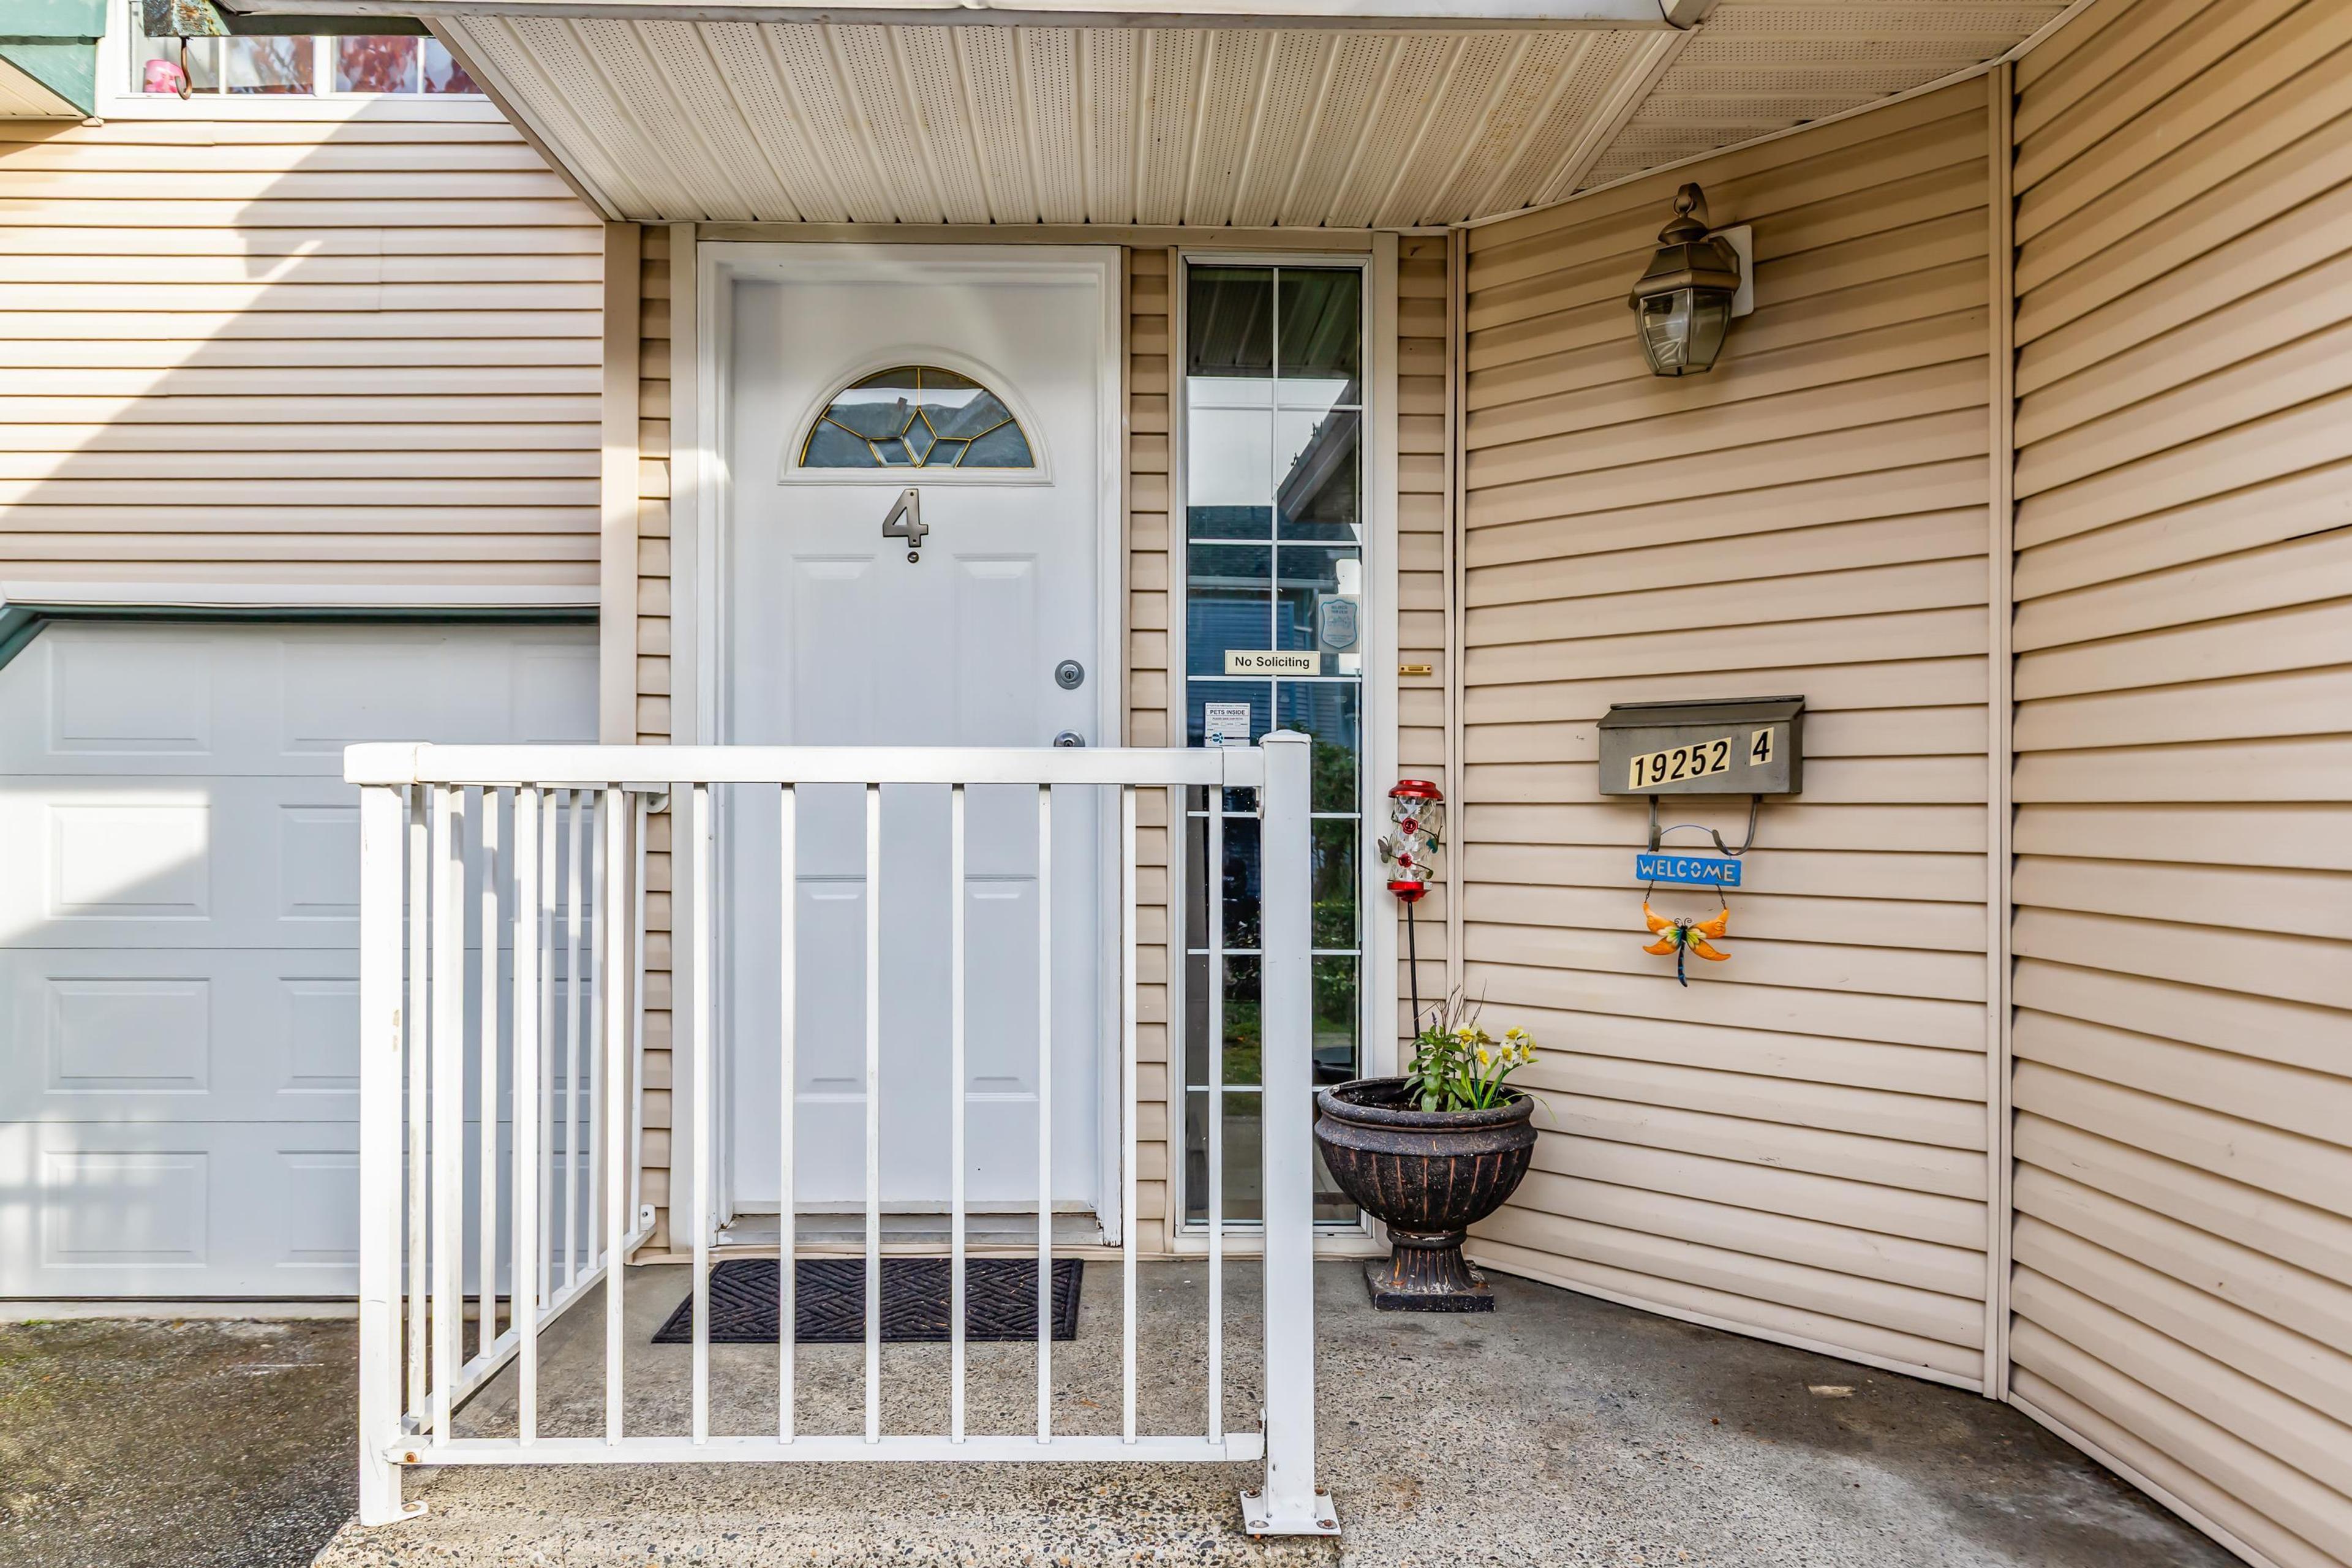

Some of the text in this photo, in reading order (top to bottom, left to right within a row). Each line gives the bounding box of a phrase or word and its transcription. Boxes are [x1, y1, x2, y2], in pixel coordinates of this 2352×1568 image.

[883, 488, 929, 548] 4
[1235, 657, 1310, 669] No Soliciting
[1635, 731, 1770, 786] 19252 4
[1639, 859, 1736, 882] WELCOME
